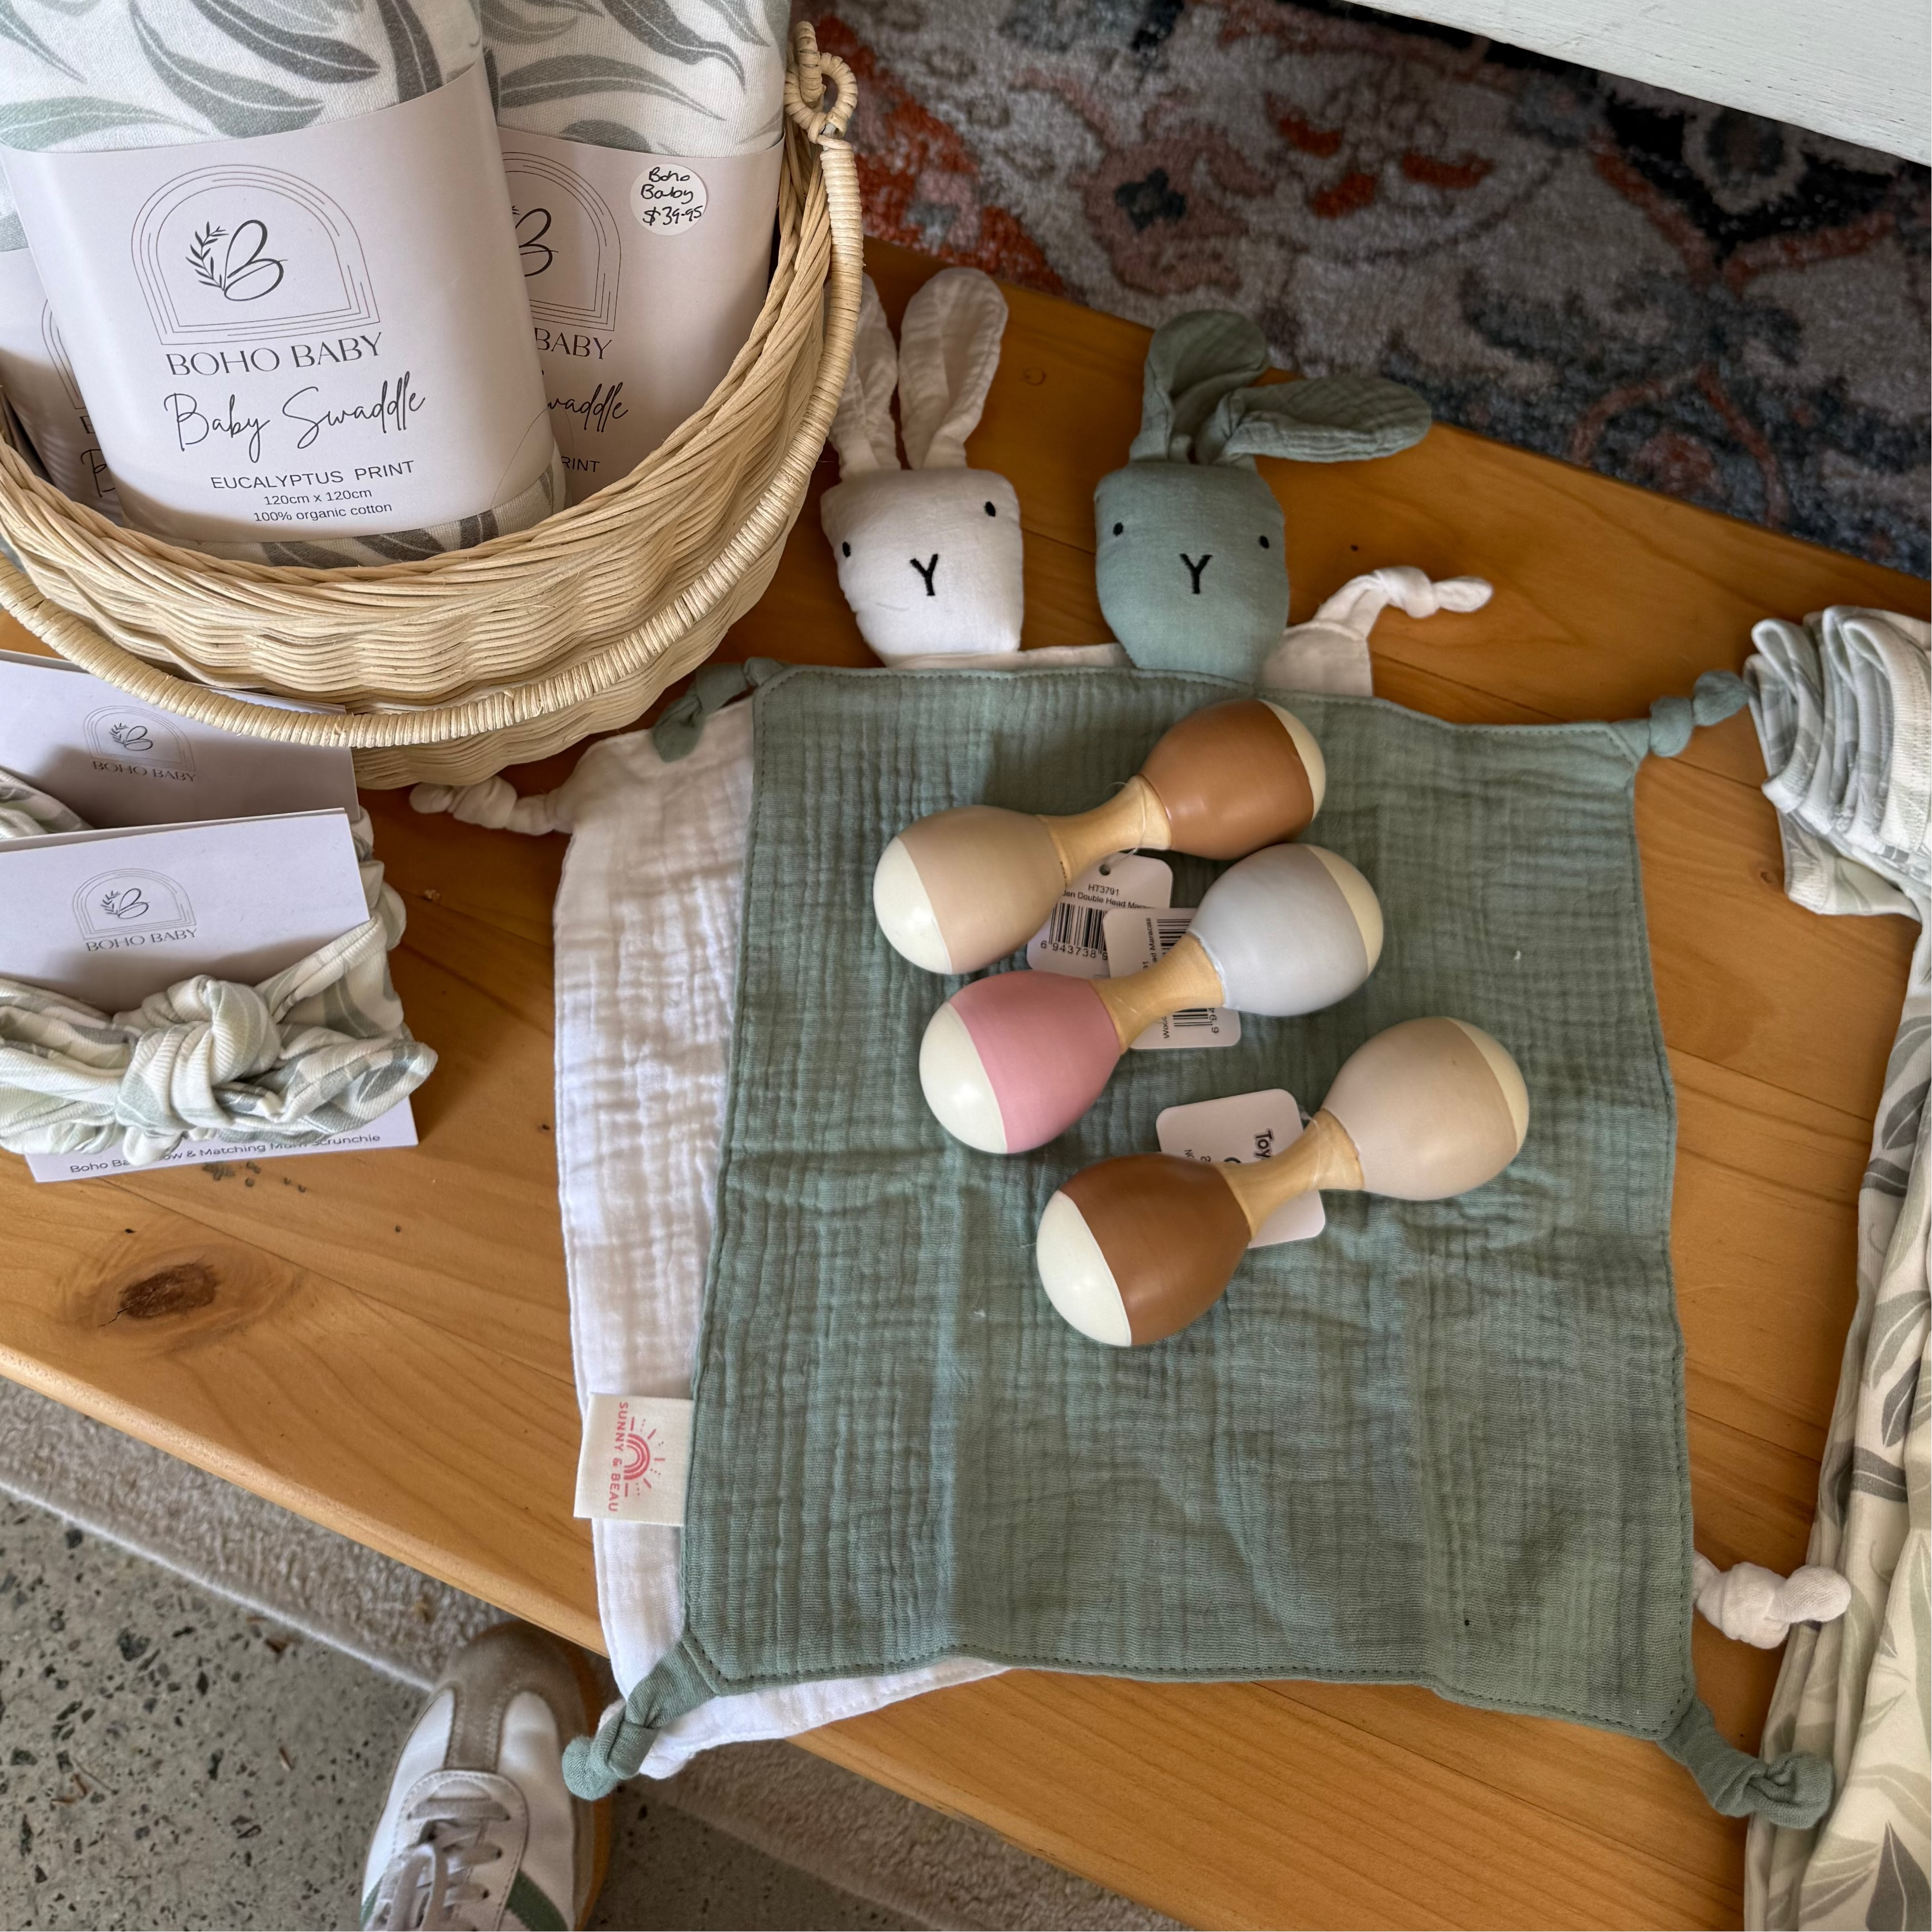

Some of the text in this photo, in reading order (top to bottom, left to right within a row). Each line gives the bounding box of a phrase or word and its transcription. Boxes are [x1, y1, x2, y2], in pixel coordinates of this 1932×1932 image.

[648, 167, 690, 182] Boho
[641, 184, 693, 205] Baby
[166, 332, 381, 376] BOHO BABY
[534, 327, 613, 360] BABY
[164, 371, 425, 463] Baby Swaddle
[547, 381, 628, 433] waddle
[210, 460, 414, 489] EUCALYPTUS PRINT
[561, 456, 600, 473] RINT
[264, 489, 372, 505] 120cm x 120cm
[254, 503, 392, 522] 100% organic cotton
[93, 761, 196, 782] BOHO BABY
[1077, 891, 1104, 904] Double
[1106, 898, 1126, 908] Head
[1088, 884, 1119, 895] HT3791
[86, 928, 197, 951] BOHO BABY
[1052, 942, 1096, 959] 943738
[70, 1159, 108, 1173] Boho
[200, 1142, 266, 1156] Matching
[608, 1402, 628, 1512] SUNNY & BEAU
